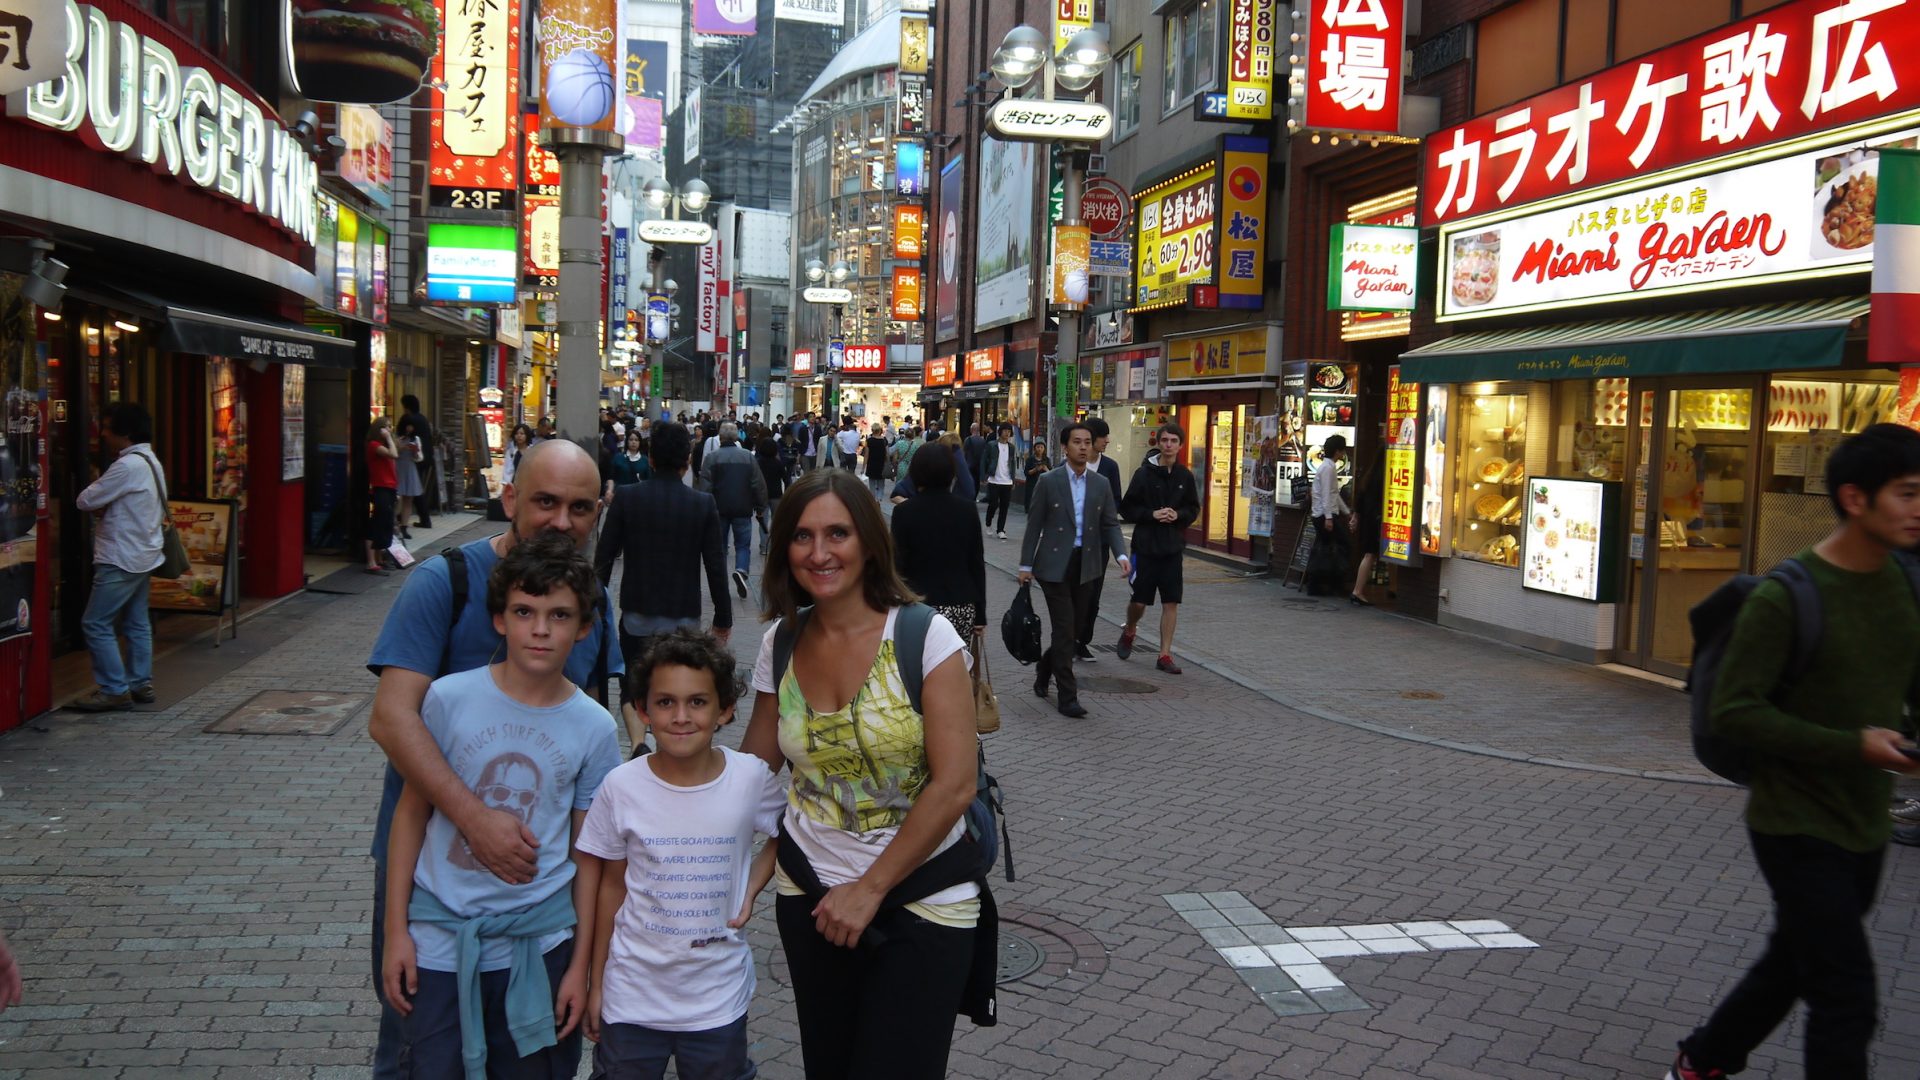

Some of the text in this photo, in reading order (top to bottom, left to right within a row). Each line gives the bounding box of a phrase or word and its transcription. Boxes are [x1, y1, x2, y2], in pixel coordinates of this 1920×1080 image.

[1205, 95, 1227, 114] 2F
[1236, 90, 1263, 104] りらく
[1000, 110, 1106, 128] 渋谷センター街
[1434, 0, 1899, 219] カラオケ歌広
[27, 0, 318, 247] BURGER KING
[527, 131, 543, 183] もんじゃ
[900, 213, 918, 224] FK
[1082, 202, 1119, 221] 消火栓
[1568, 187, 1708, 238] パスタとピザの店
[1160, 242, 1179, 265] 60分
[1227, 210, 1259, 280] 松屋
[434, 254, 496, 267] FamilyMart
[1511, 231, 1621, 284] Miami
[1658, 252, 1757, 278] マイアミガーデン
[1343, 260, 1399, 276] Miami
[898, 275, 916, 286] FK
[700, 281, 715, 333] factory
[1207, 339, 1231, 371] 松屋
[1389, 467, 1410, 487] 145
[1387, 499, 1409, 519] 370
[463, 726, 497, 758] MUCH
[502, 722, 537, 741] SURF
[535, 732, 556, 752] ON
[655, 836, 679, 846] ESISTE
[686, 856, 698, 864] UN
[655, 890, 689, 900] TROVARSI
[650, 905, 672, 918] SOTTO
[672, 910, 683, 918] UN
[683, 909, 701, 918] SOLE
